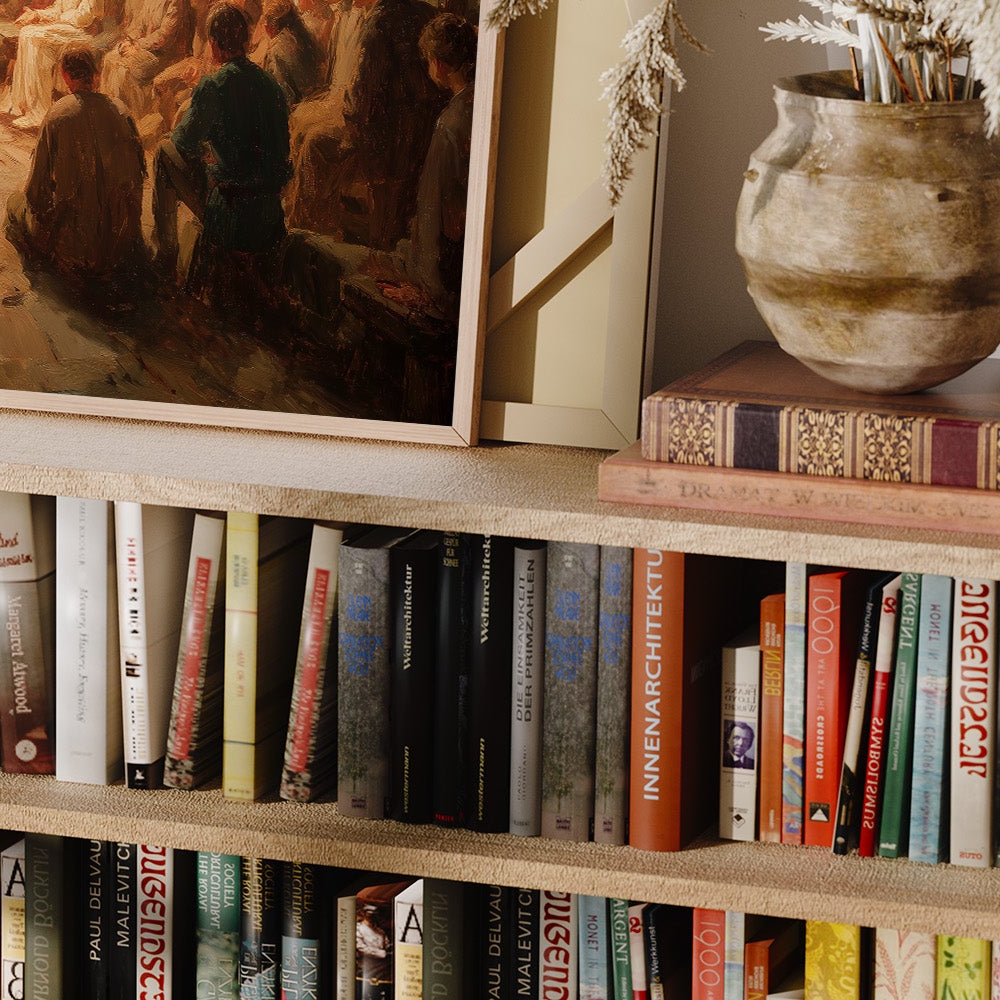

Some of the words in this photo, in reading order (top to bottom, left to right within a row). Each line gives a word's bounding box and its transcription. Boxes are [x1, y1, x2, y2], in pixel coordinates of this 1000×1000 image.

[5, 595, 25, 658] Margaret
[402, 563, 413, 671] Weltarchitektur
[524, 559, 535, 680] PRIMZAHLEN
[12, 661, 32, 715] Atwood
[523, 684, 533, 723] DER
[643, 549, 664, 802] INNENARCHITEKTU
[477, 737, 485, 821] westermann
[89, 839, 101, 910] DELVAU
[89, 915, 101, 961] PAUL
[488, 885, 501, 957] DELVAU
[587, 914, 599, 953] MONET
[648, 925, 660, 975] Werkkunst
[694, 921, 722, 987] 1900
